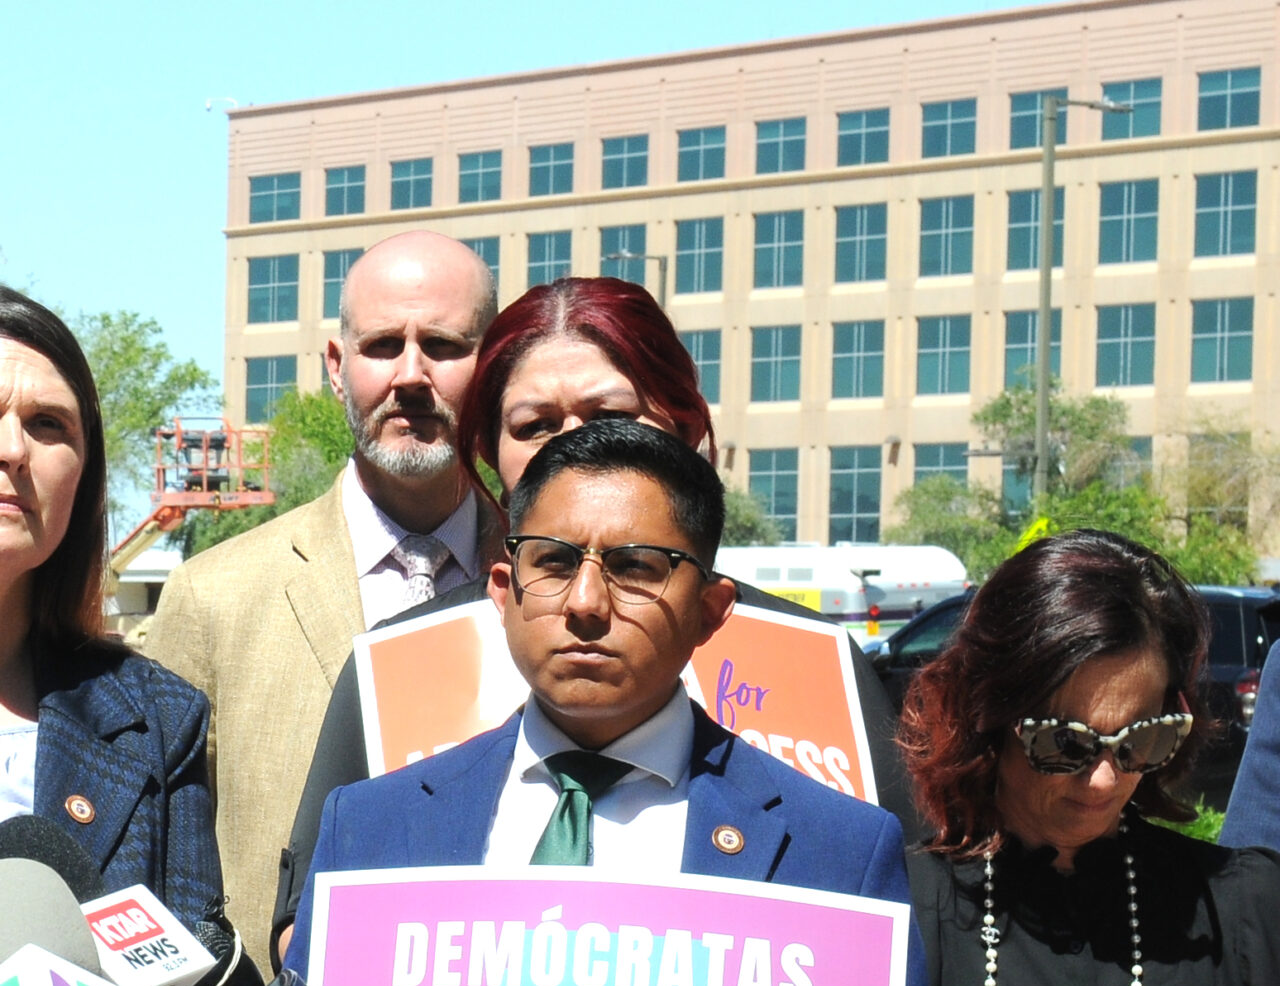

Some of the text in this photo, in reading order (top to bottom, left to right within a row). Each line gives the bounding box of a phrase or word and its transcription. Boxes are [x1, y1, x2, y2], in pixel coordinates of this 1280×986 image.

[716, 658, 770, 730] for
[91, 907, 157, 945] KTAR
[121, 938, 179, 970] NEWS
